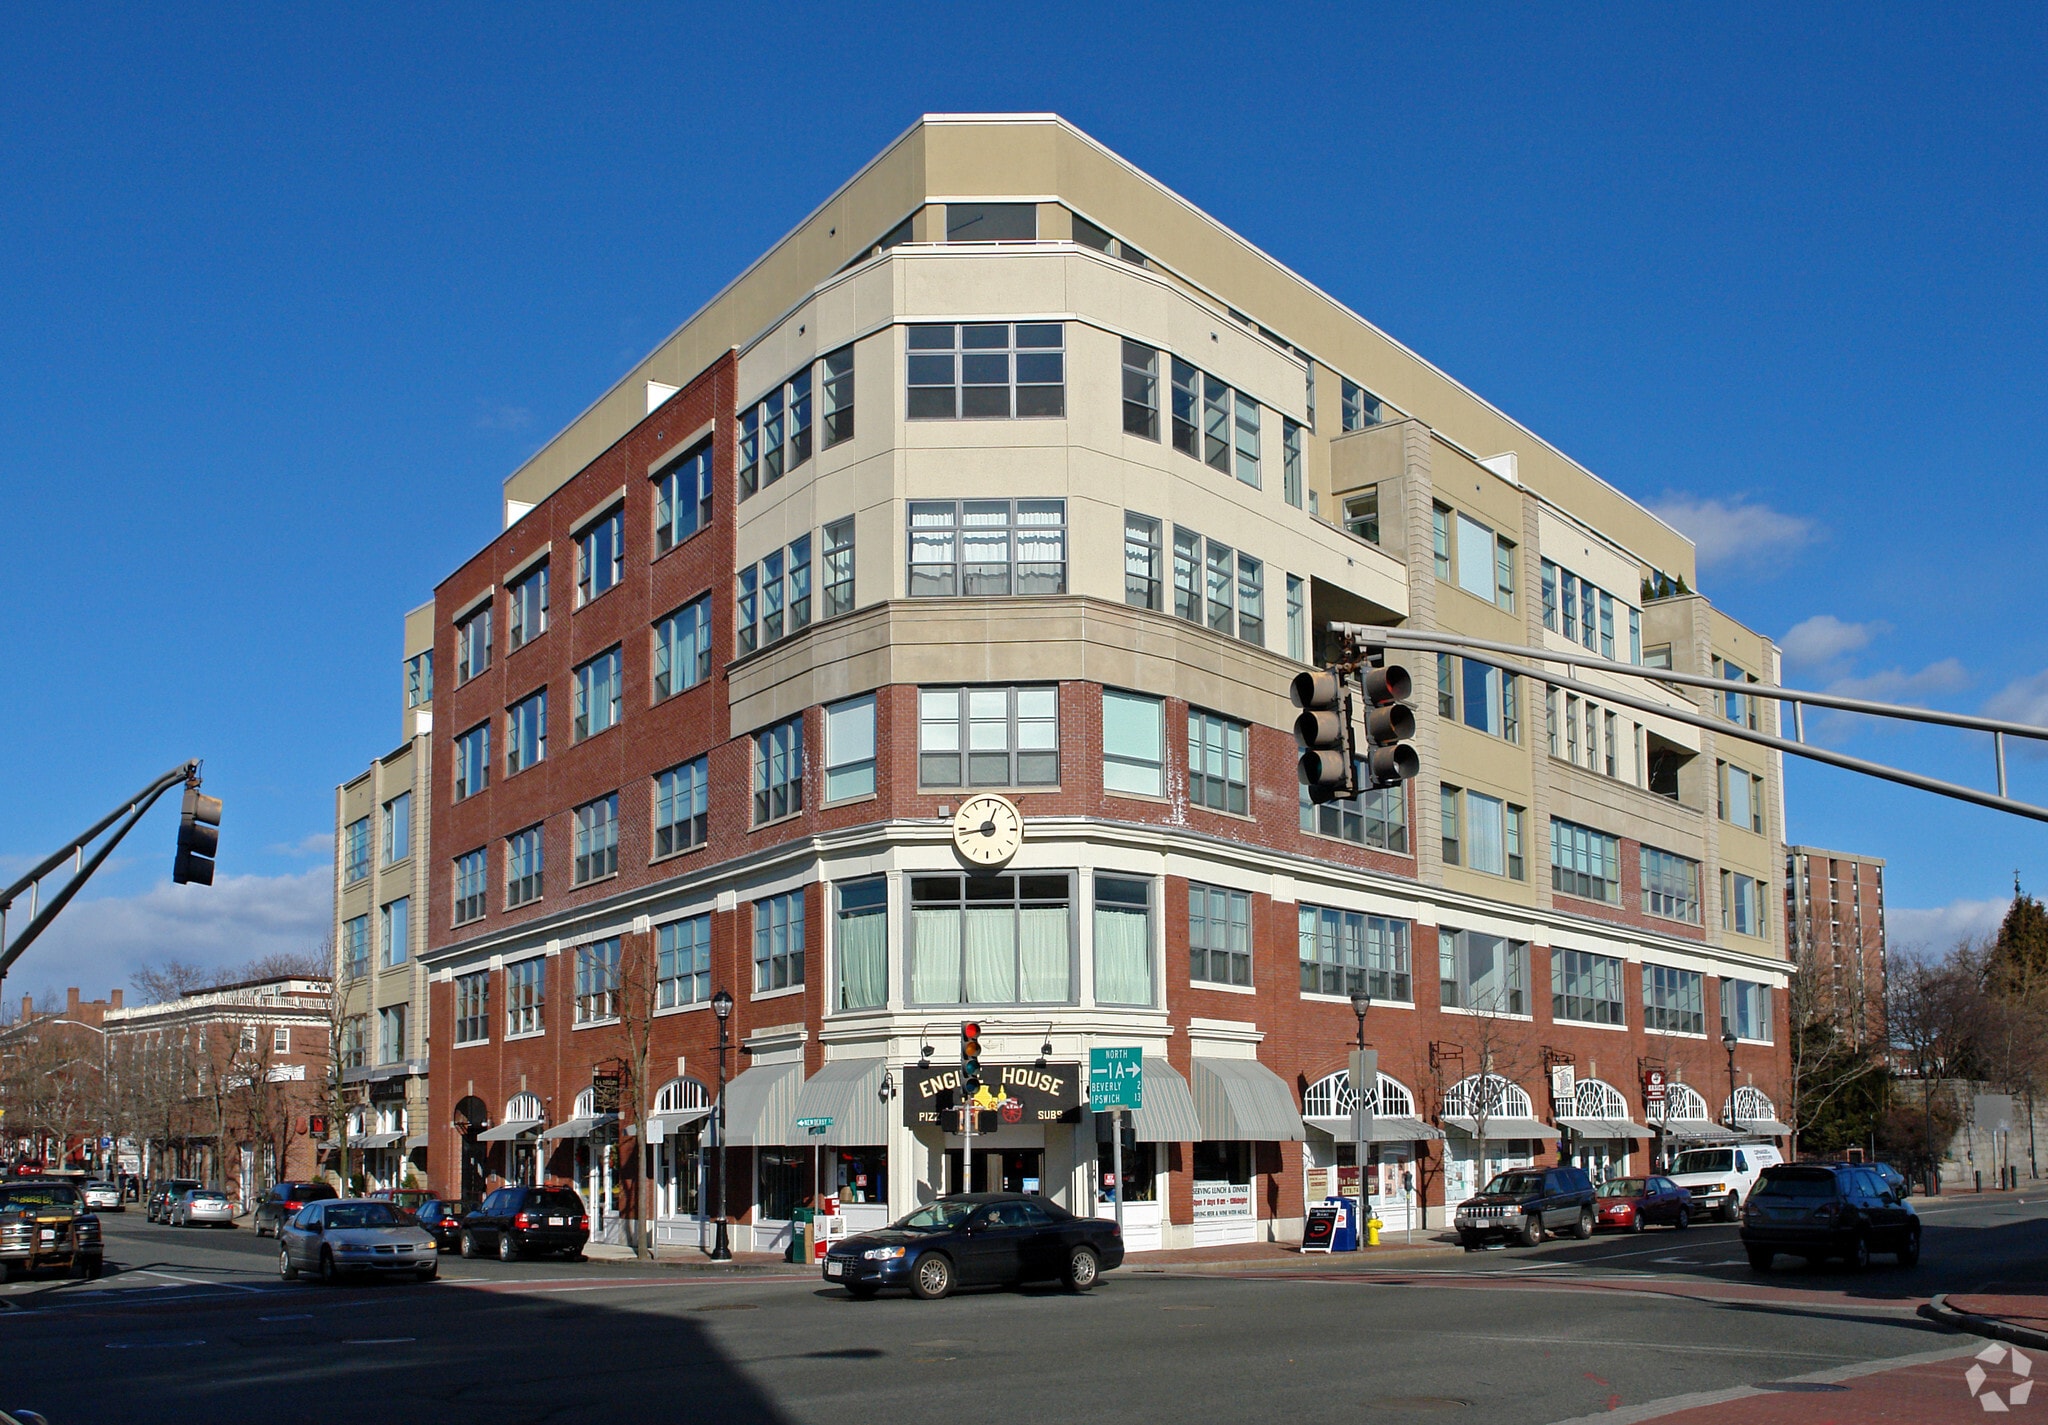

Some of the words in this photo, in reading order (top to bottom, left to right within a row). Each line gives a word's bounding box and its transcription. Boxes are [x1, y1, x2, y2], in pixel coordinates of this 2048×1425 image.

[1105, 1049, 1128, 1059] NORTH
[1108, 1061, 1125, 1079] 1A
[919, 1068, 983, 1098] ENGI
[1001, 1067, 1064, 1096] HOUSE
[1091, 1081, 1122, 1092] BEVERLY
[1136, 1080, 1141, 1090] 2
[1091, 1093, 1121, 1104] IPSWICH
[1134, 1092, 1141, 1102] 13
[1037, 1110, 1063, 1120] SUBS
